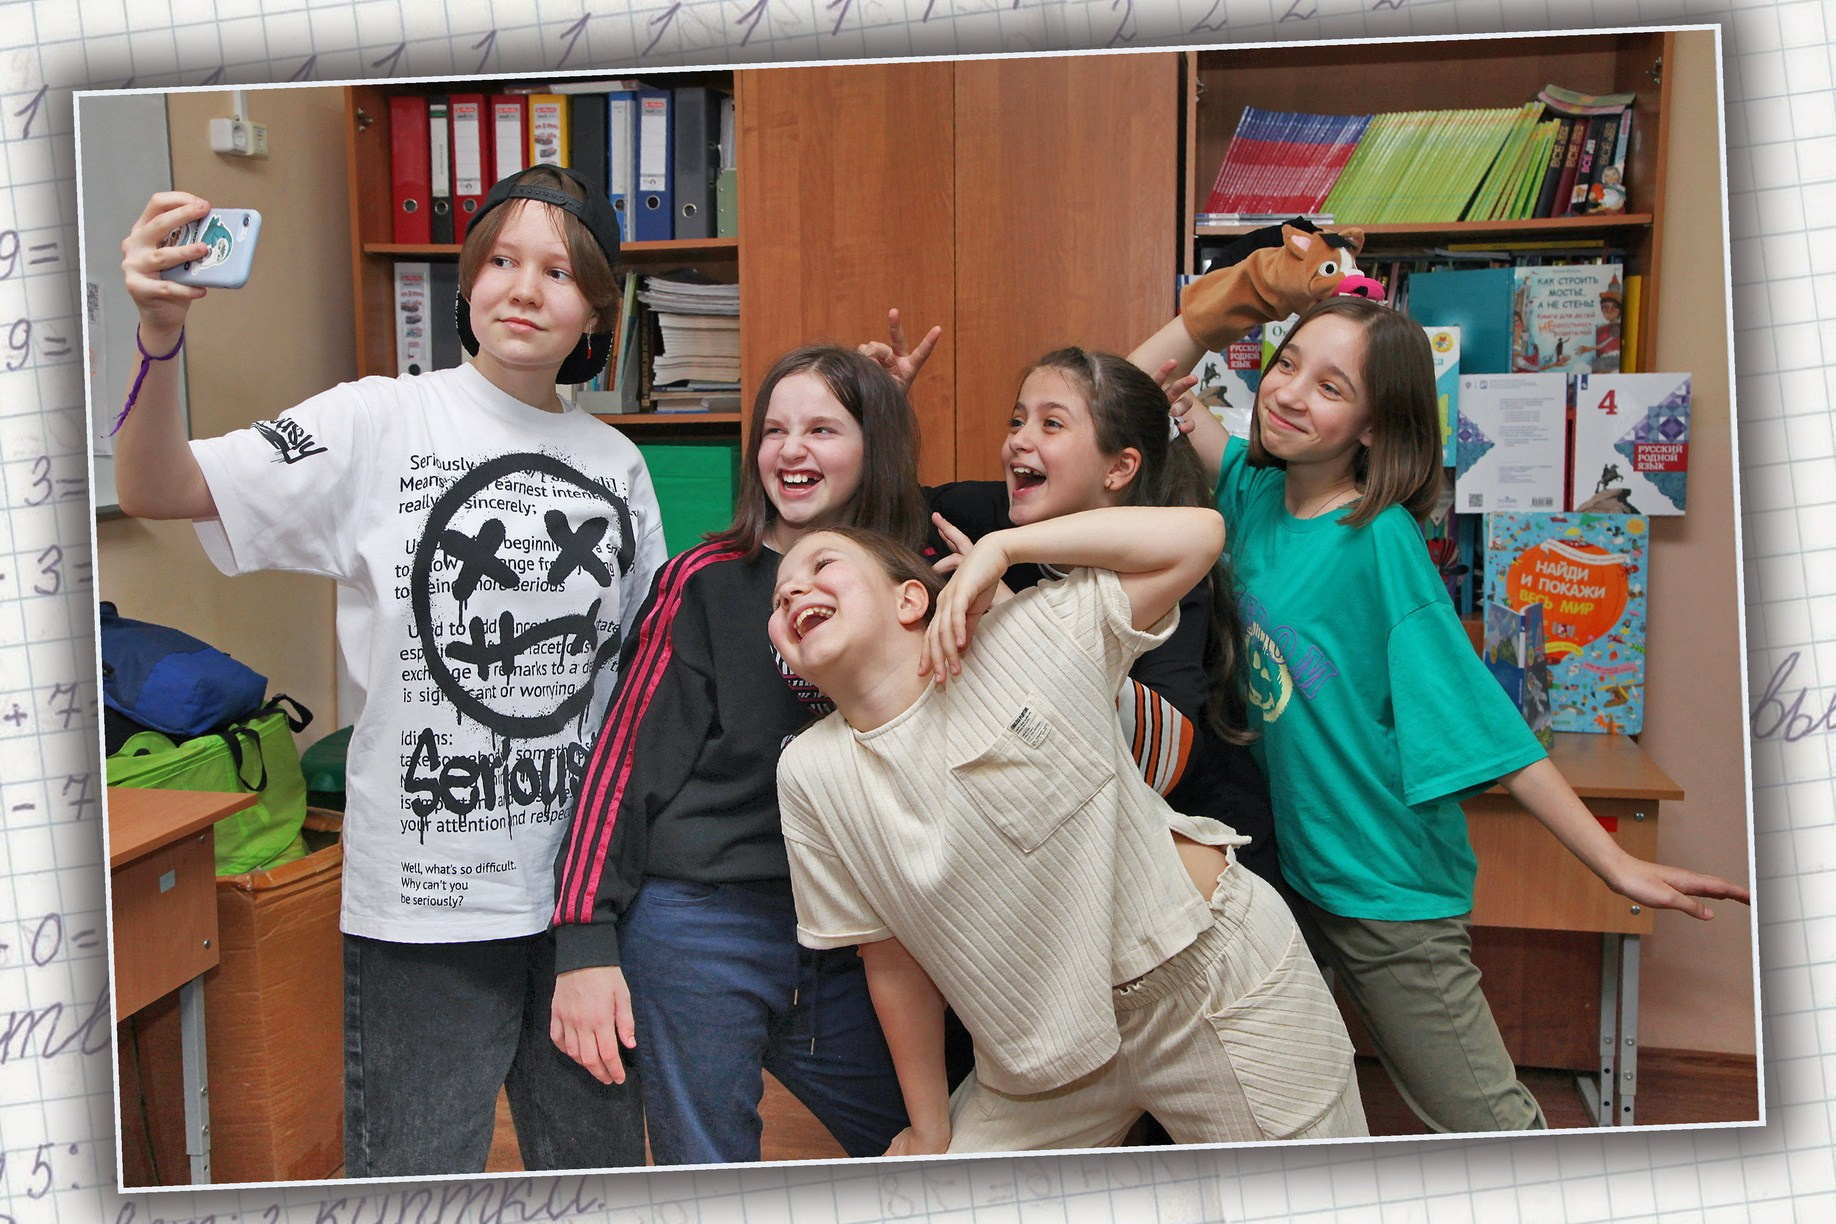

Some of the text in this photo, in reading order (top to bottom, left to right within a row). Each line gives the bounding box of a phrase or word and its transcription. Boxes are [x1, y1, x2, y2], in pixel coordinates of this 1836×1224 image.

[1537, 276, 1599, 286] КАК СТРОИТЬ
[1537, 299, 1595, 309] А НЕ СТЕНЫ
[1598, 390, 1617, 415] 4
[1637, 444, 1683, 454] РУССКИЙ
[1637, 453, 1679, 463] РОДНОЙ
[1637, 462, 1665, 471] ЯЗЫК
[1535, 560, 1590, 582] НАЙДИ
[1521, 573, 1606, 599] И ПОКАЖИ
[1519, 589, 1595, 615] ВЕСЬ МИР
[436, 815, 506, 833] attention
[400, 860, 517, 876] Well, what's so difficult.
[400, 876, 469, 893] Why can't you
[400, 893, 464, 909] be seriously?
